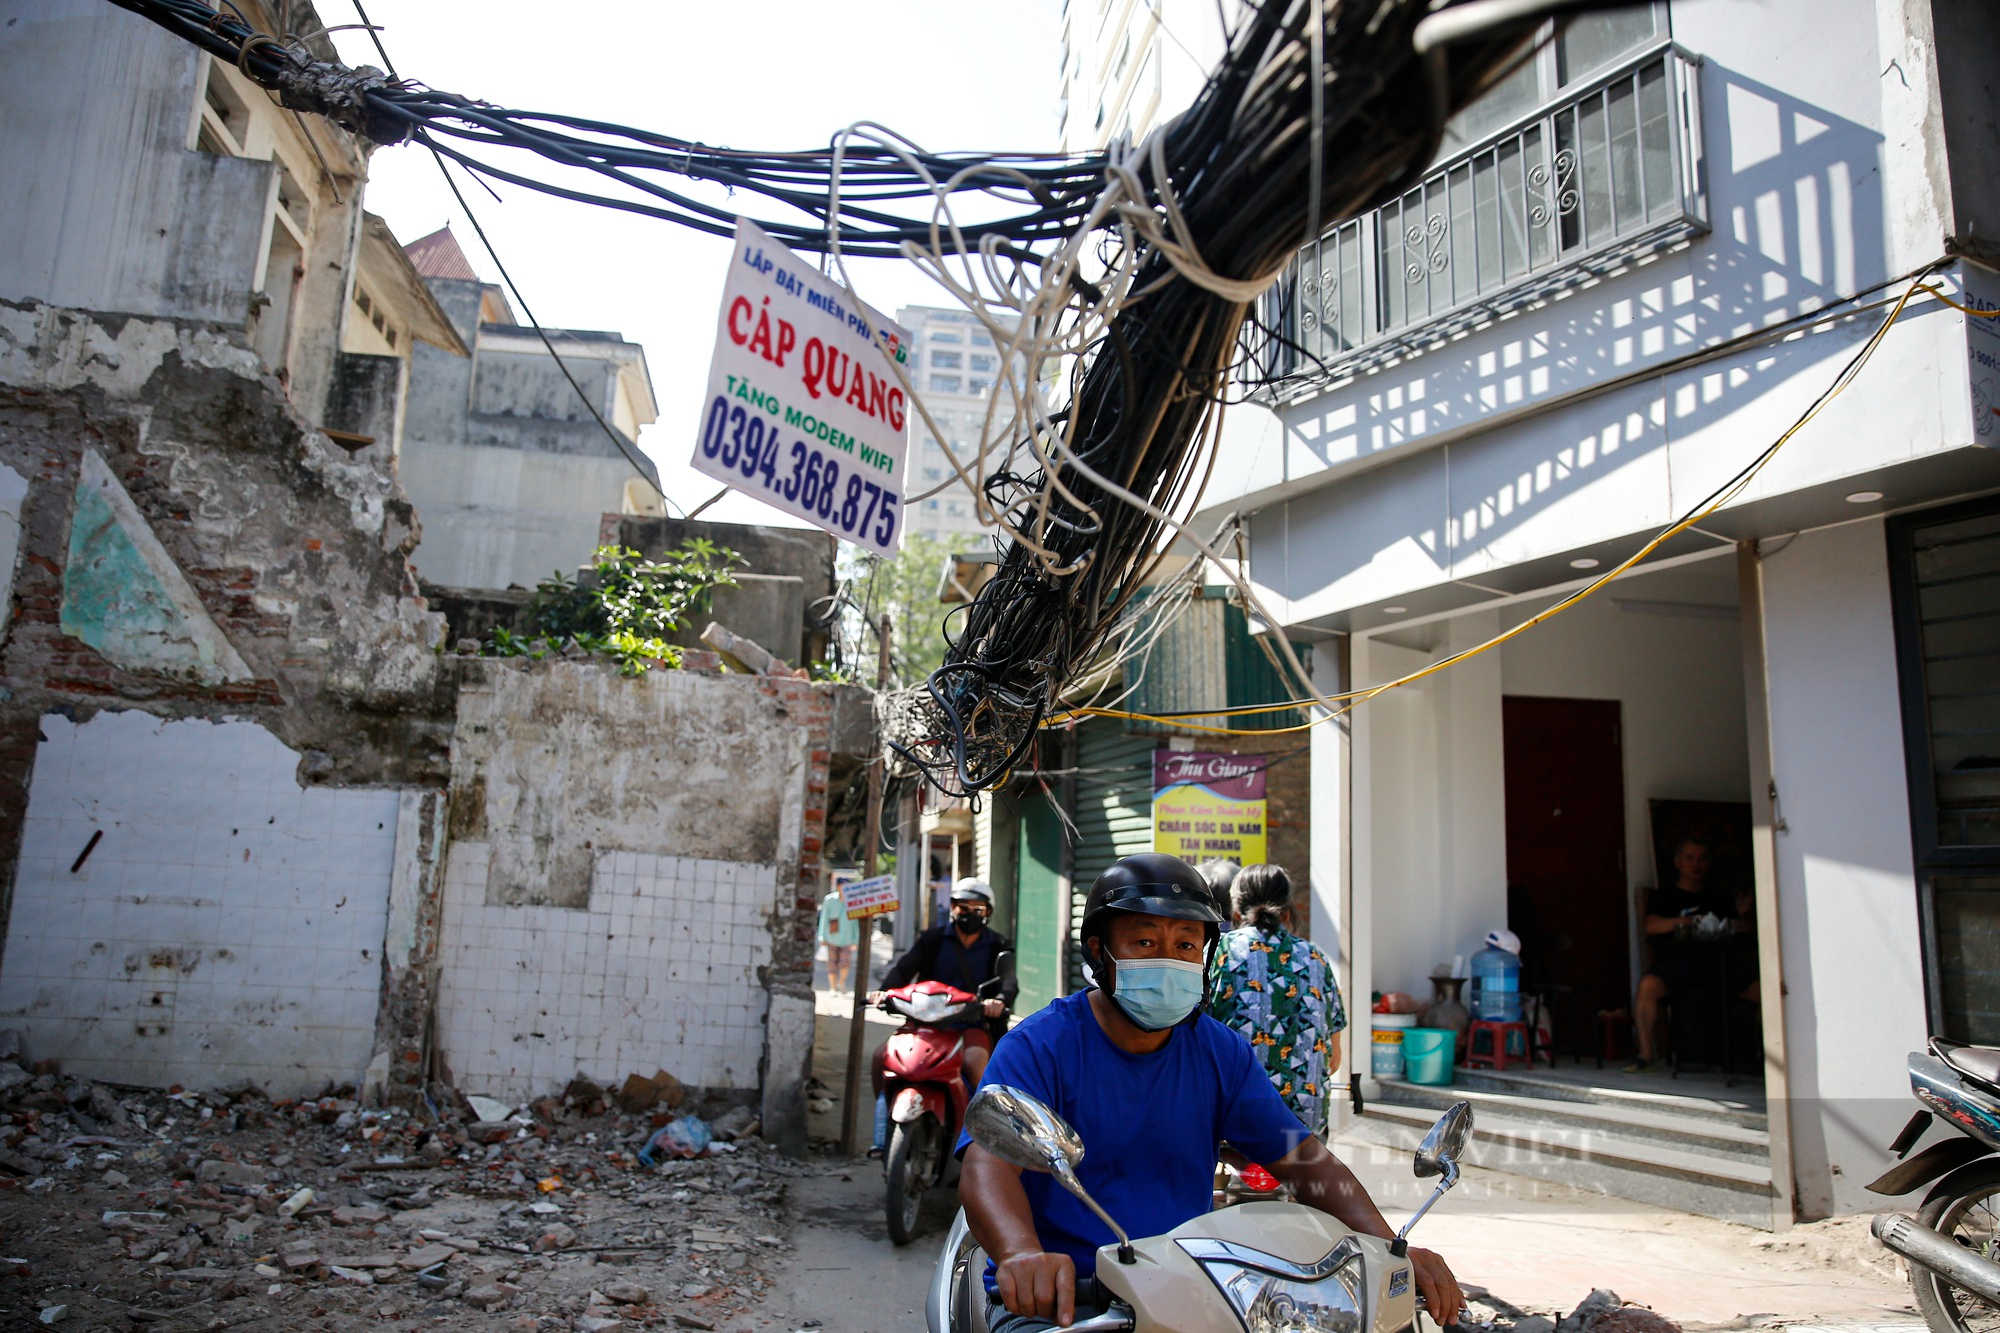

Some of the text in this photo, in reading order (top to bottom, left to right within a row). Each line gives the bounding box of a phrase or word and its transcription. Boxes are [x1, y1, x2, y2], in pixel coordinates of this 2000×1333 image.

[728, 295, 905, 432] CÁP QUANG
[784, 405, 856, 455] MODEM
[860, 441, 894, 475] WIFI
[703, 395, 898, 548] 0394.368.875
[1207, 757, 1258, 788] Giang
[1203, 839, 1242, 851] NHANG
[1221, 823, 1235, 834] DA
